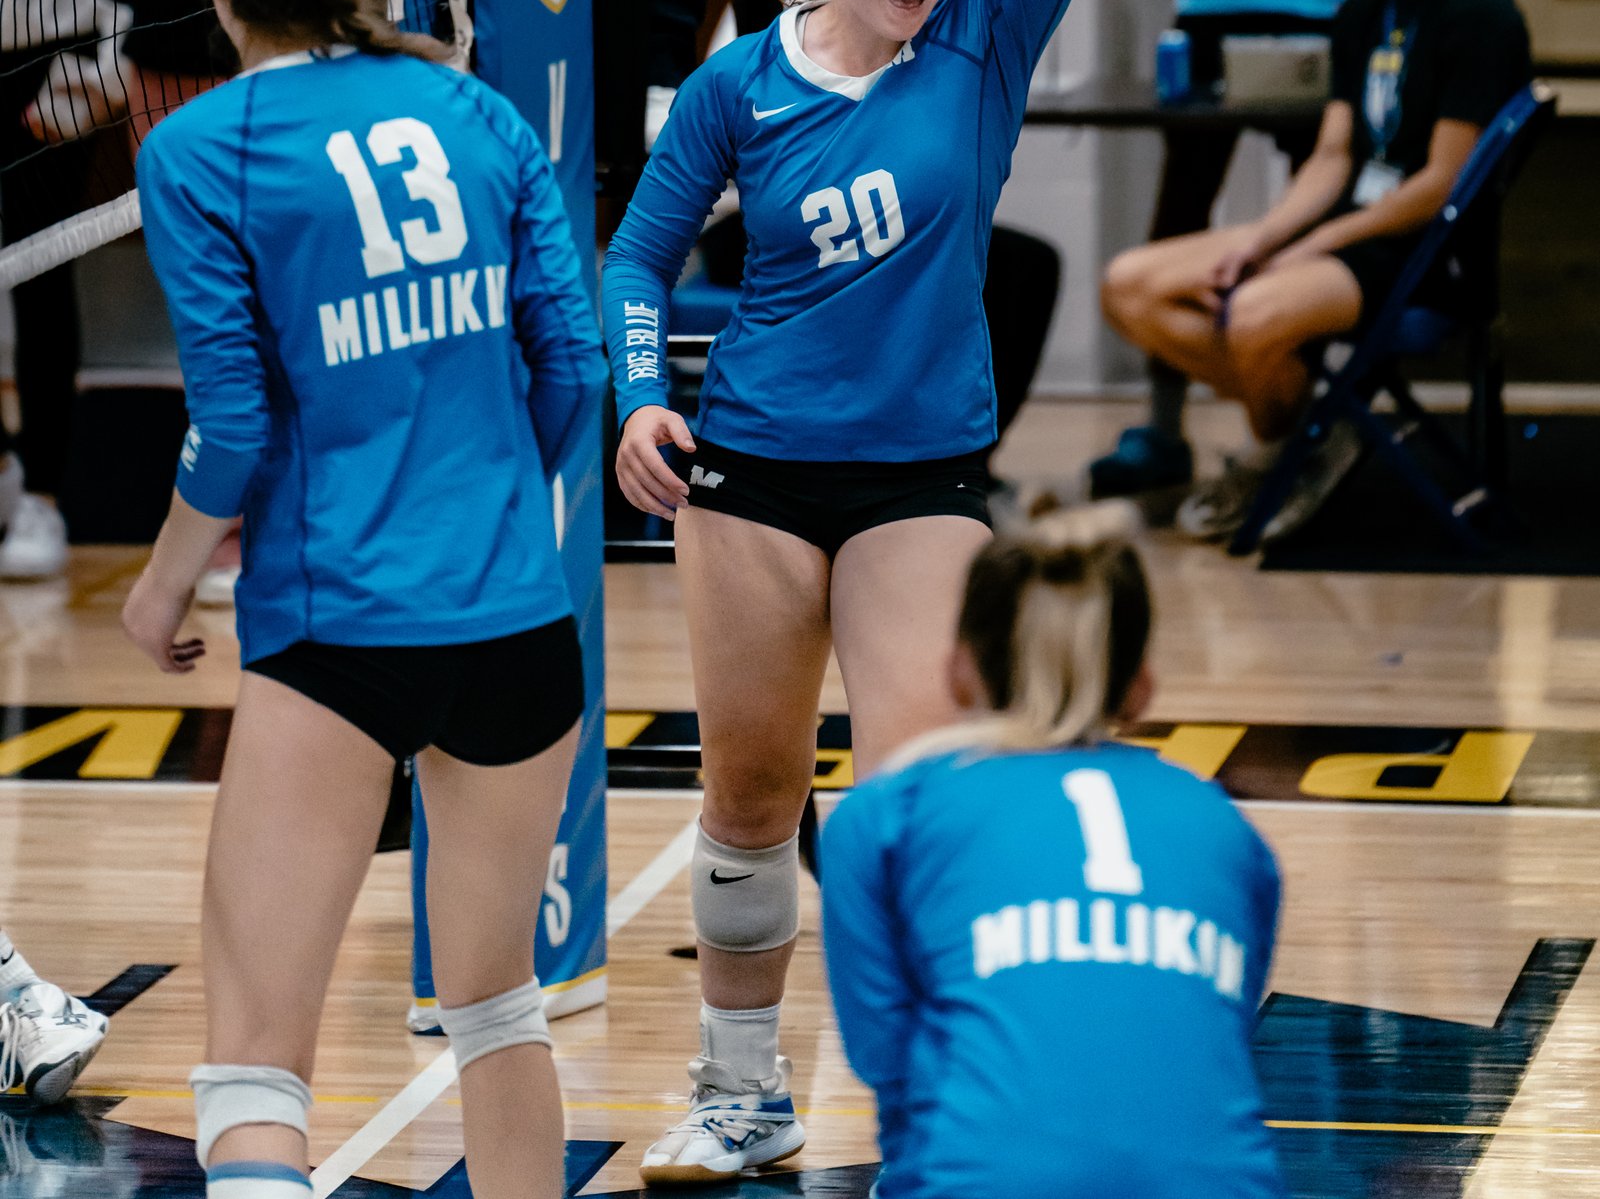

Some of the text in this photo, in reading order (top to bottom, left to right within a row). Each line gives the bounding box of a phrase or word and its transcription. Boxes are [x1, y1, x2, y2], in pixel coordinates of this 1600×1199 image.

[325, 116, 468, 279] 13
[800, 168, 906, 269] 20
[624, 301, 659, 383] BIG BLUE
[1061, 767, 1144, 896] 1
